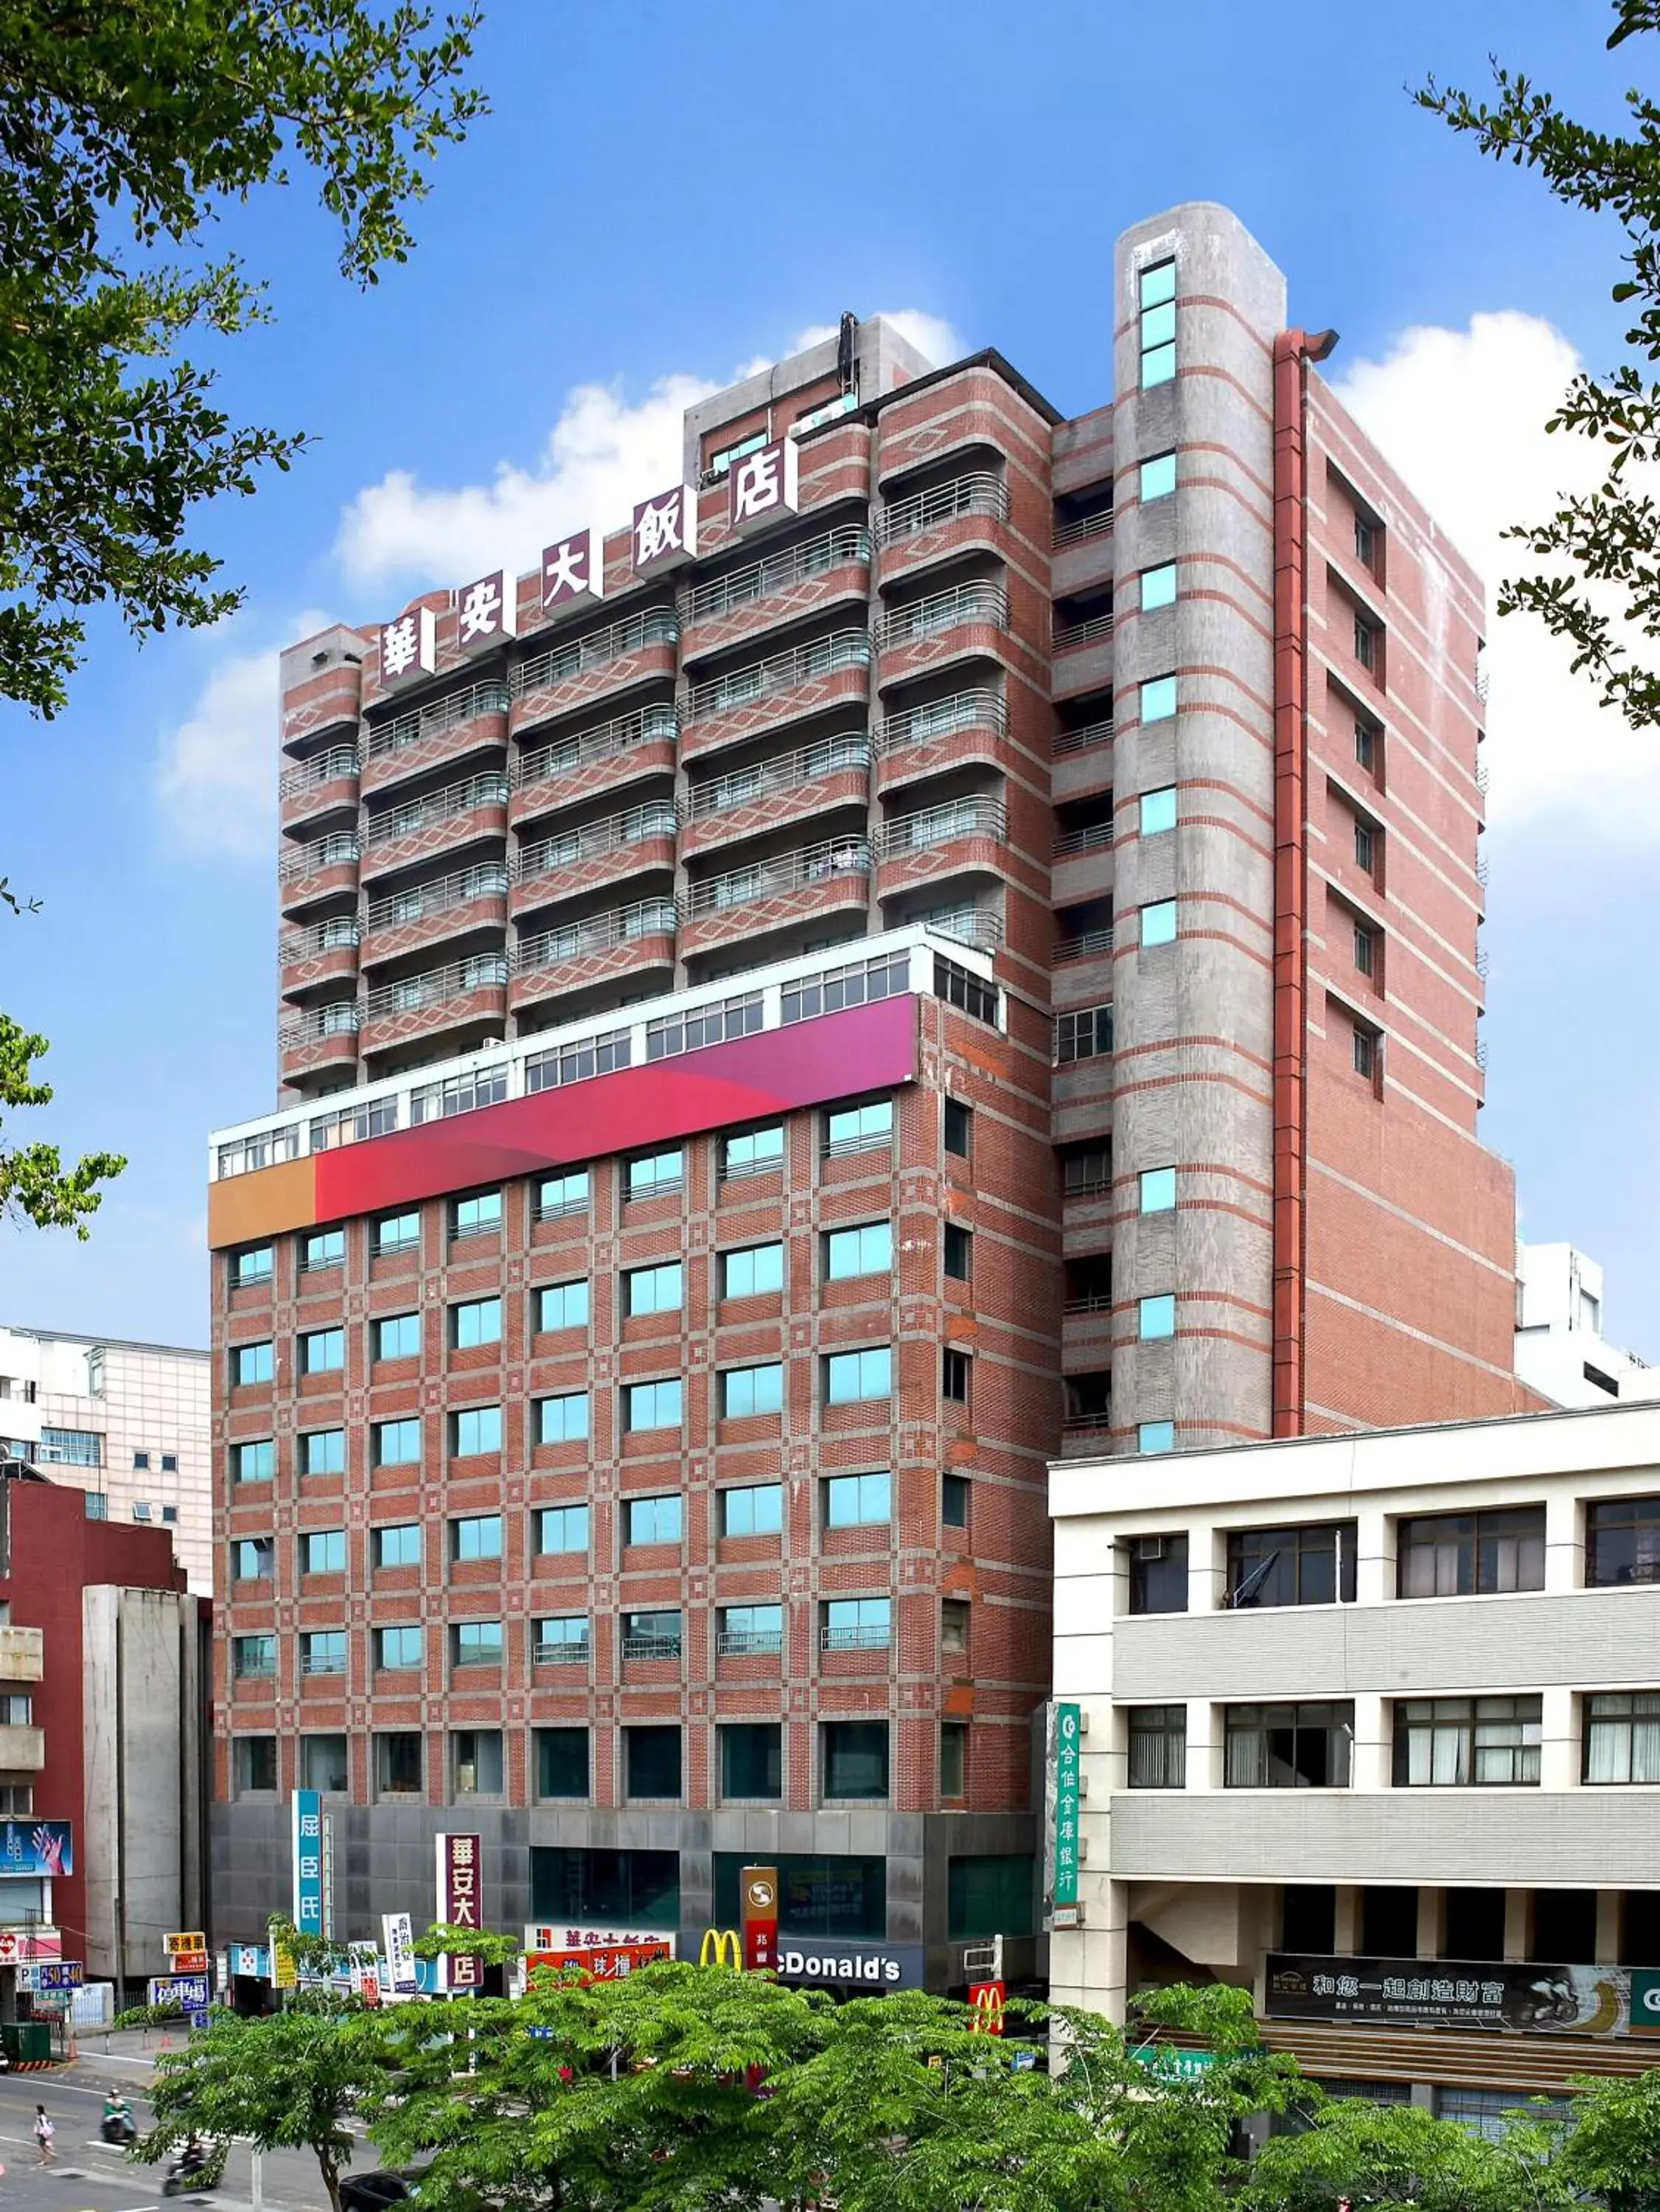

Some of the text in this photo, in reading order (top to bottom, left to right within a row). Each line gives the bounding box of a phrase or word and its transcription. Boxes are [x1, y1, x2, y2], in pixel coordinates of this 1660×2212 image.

[381, 447, 781, 676] 華安大飯店
[300, 1814, 319, 1919] 屈臣氏
[452, 1837, 475, 1984] 華安大店
[777, 1951, 901, 1981] cDonald's
[1312, 1973, 1505, 2004] 和您一起創造財富
